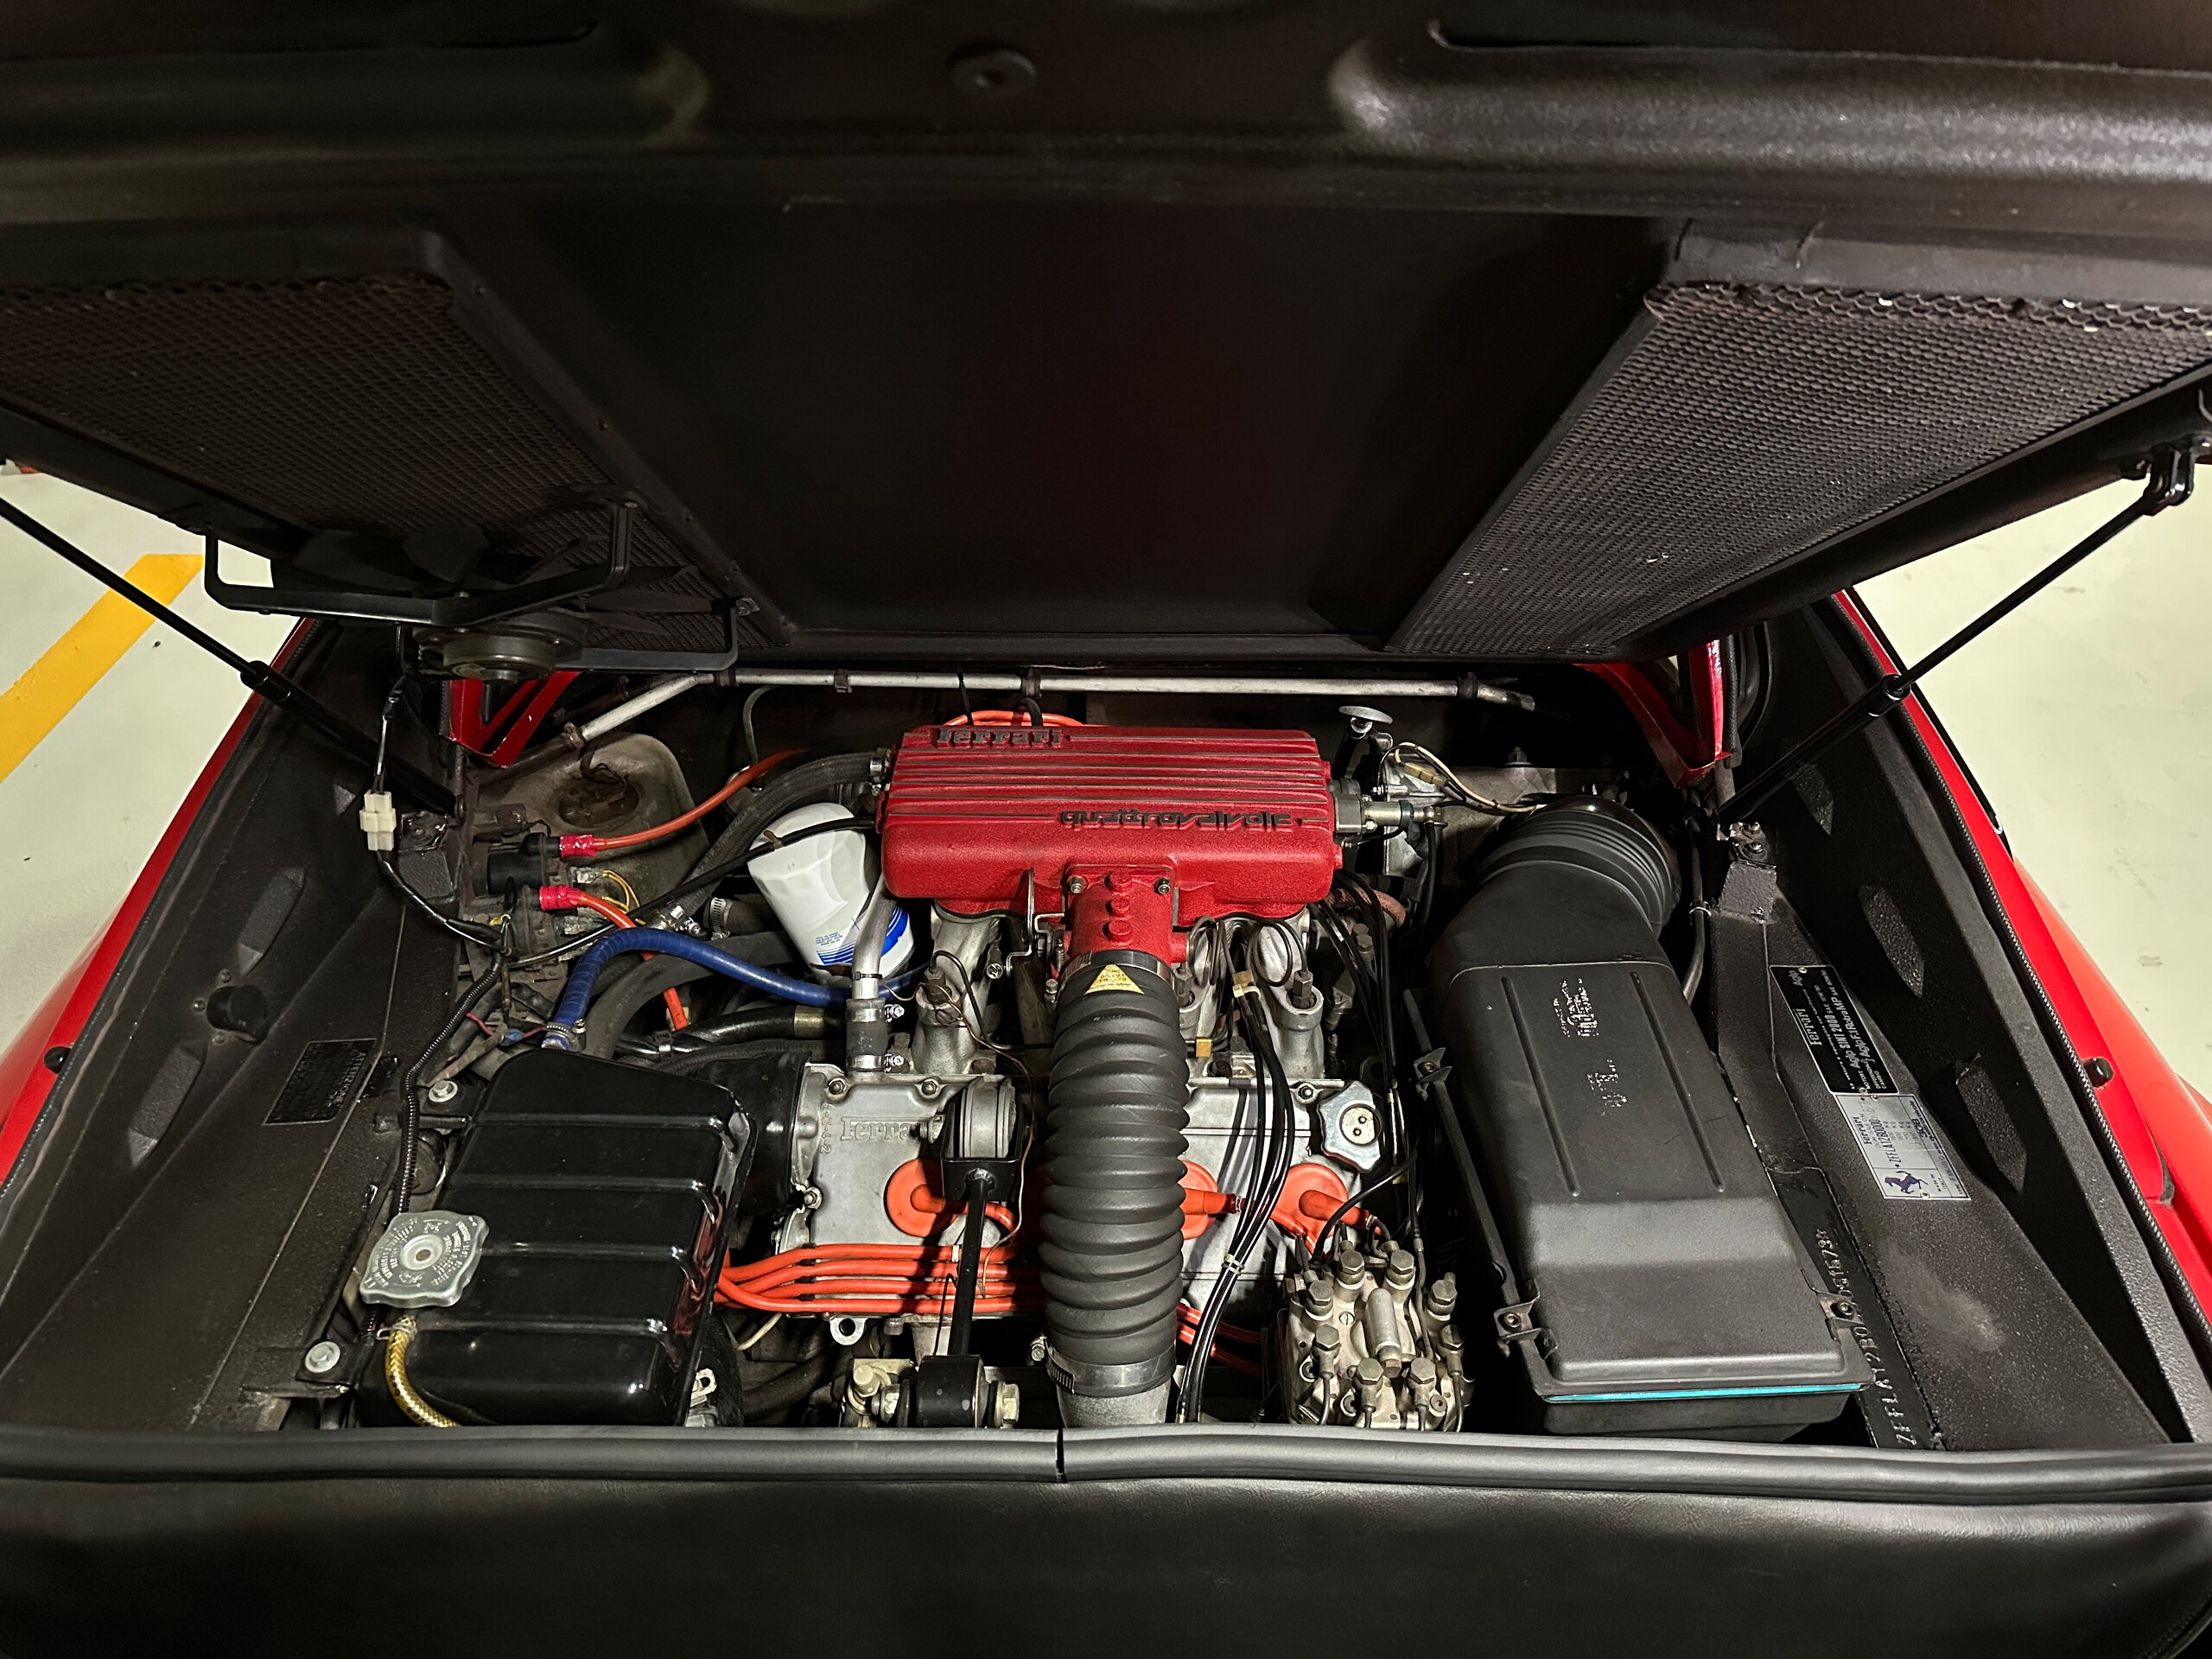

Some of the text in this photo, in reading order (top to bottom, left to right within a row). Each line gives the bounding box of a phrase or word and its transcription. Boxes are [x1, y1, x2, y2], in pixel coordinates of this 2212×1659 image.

[938, 726, 1062, 746] Ferrari
[1061, 810, 1293, 830] quattrovalvole
[1788, 969, 1804, 985] Agip
[1822, 1004, 1833, 1013] SAE
[1792, 1008, 1822, 1045] Ferrari
[1823, 1014, 1843, 1032] 2000
[1833, 1033, 1851, 1048] SINT
[1852, 1039, 1872, 1057] Agip
[1842, 1050, 1863, 1068] Agip
[1858, 1070, 1872, 1089] MOTORE
[1872, 1071, 1887, 1089] CAMBIO
[1850, 1116, 1872, 1144] Ferrari
[1910, 1118, 1929, 1137] 308
